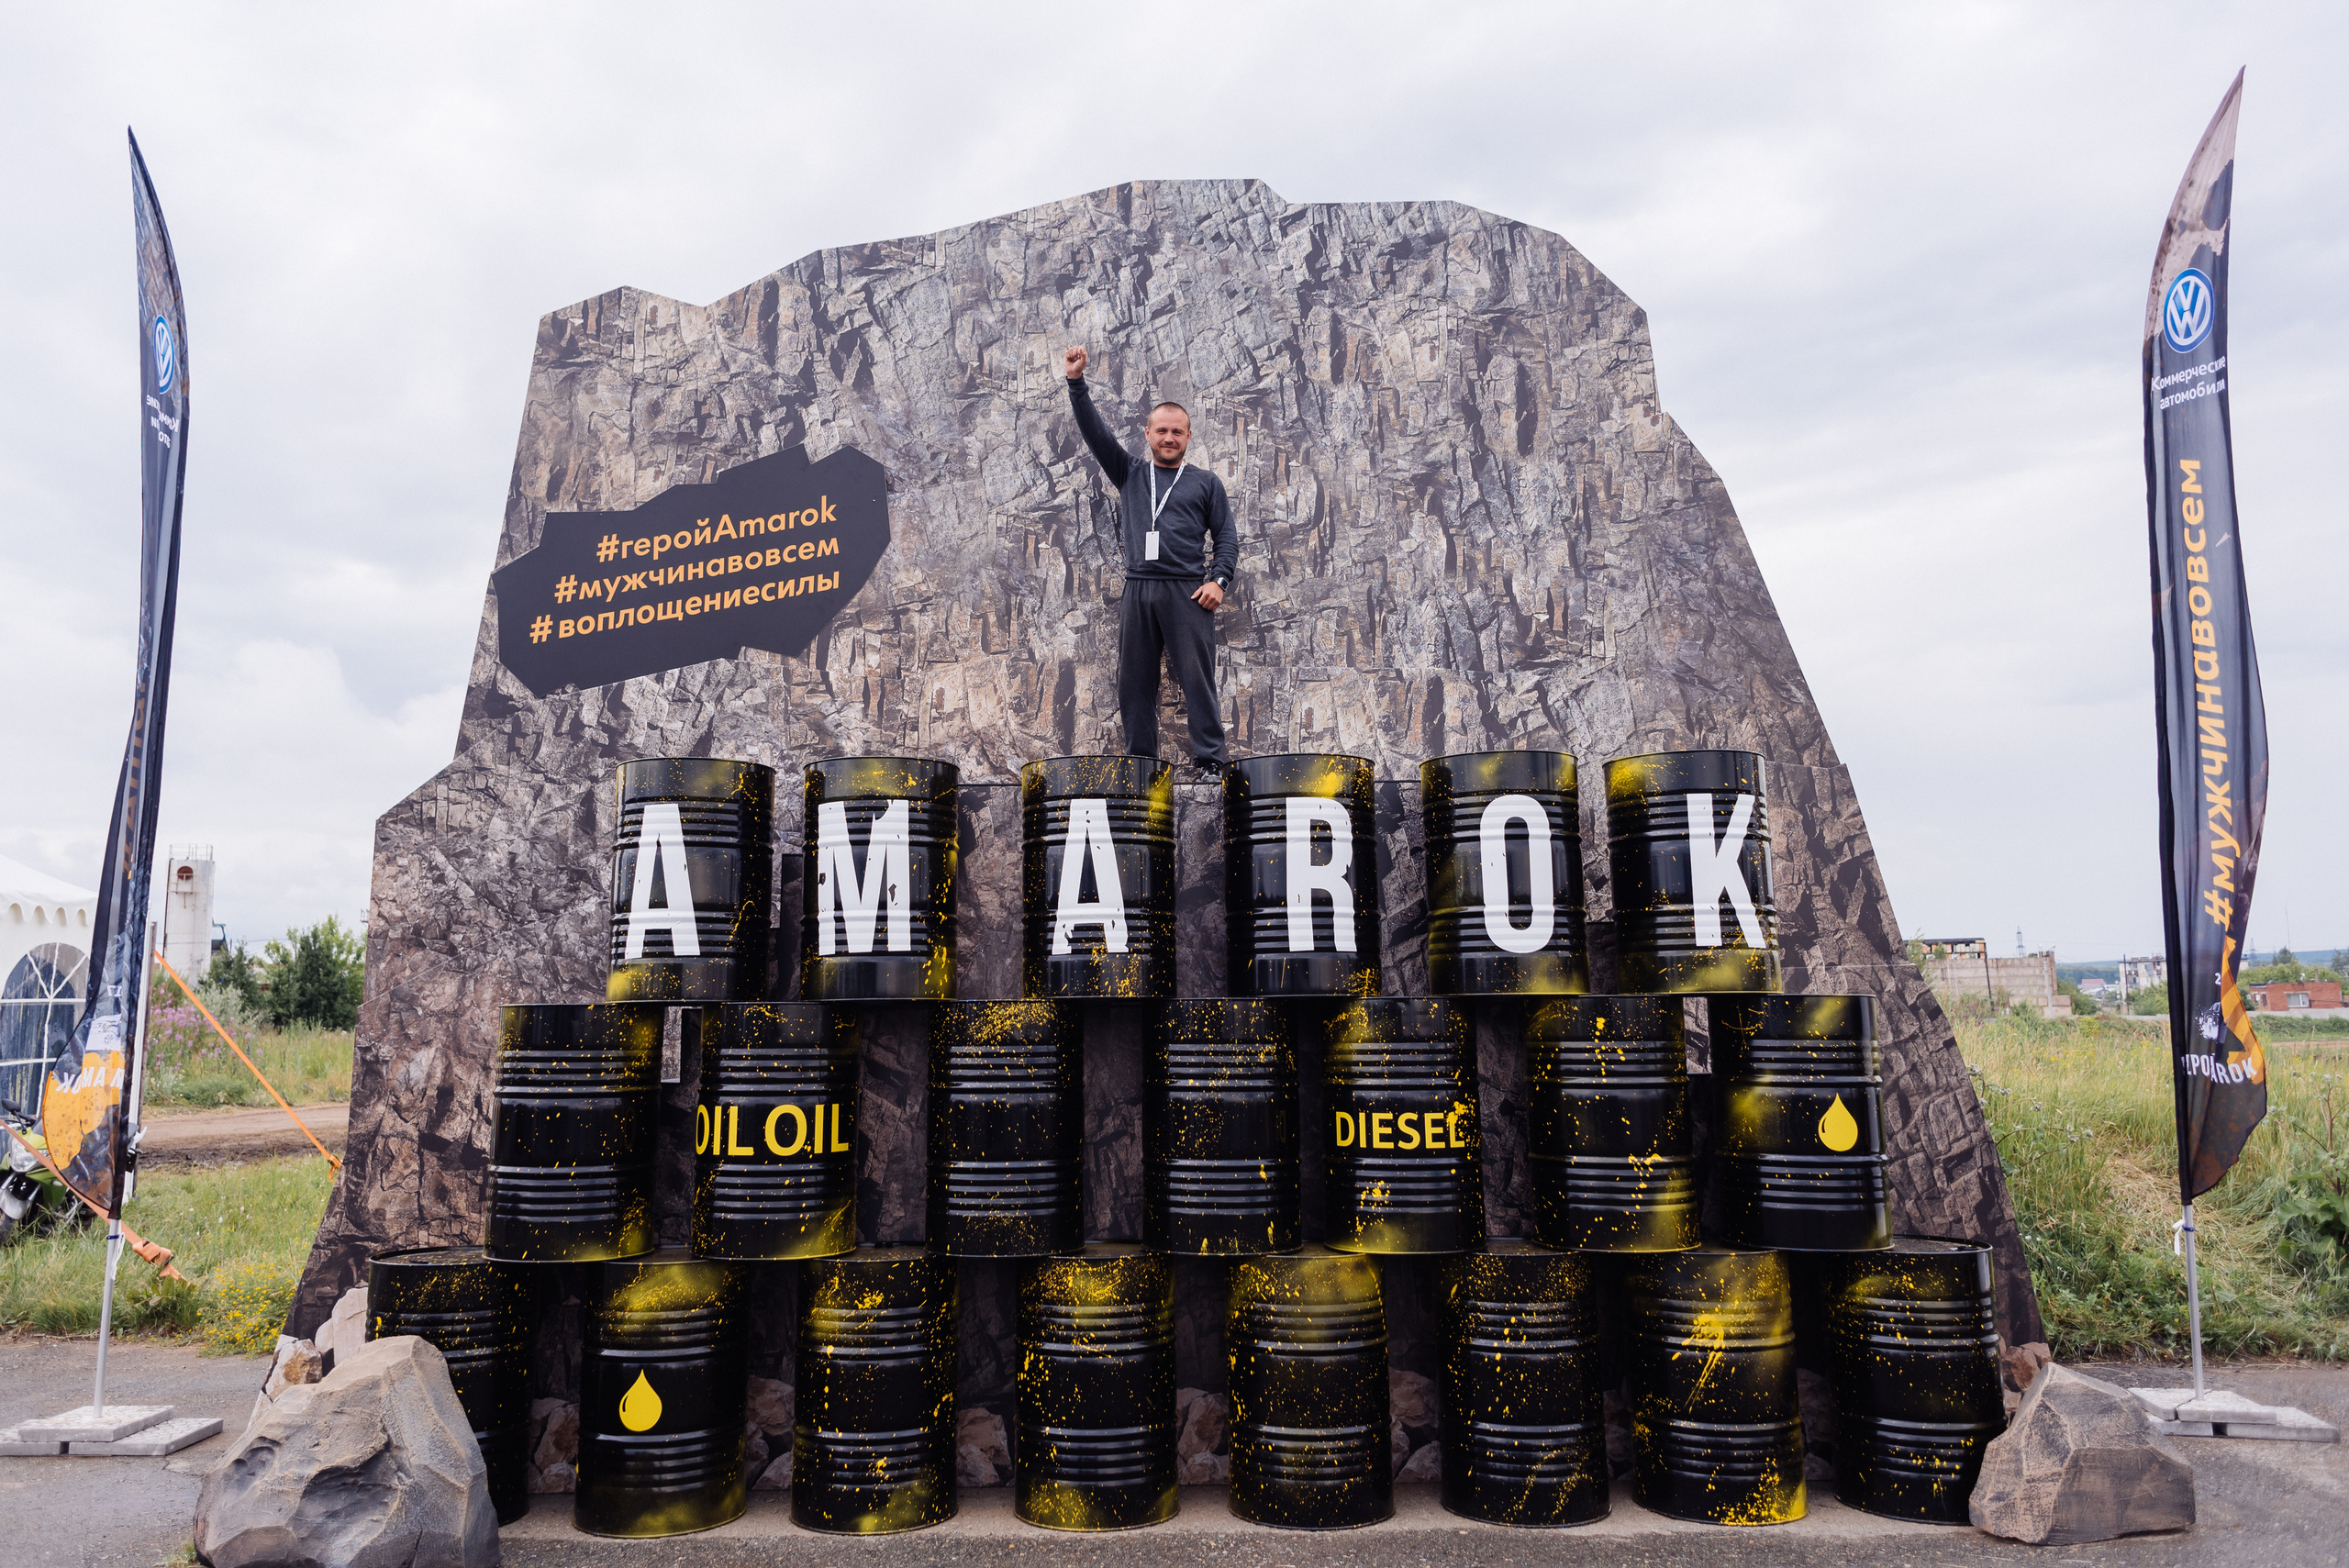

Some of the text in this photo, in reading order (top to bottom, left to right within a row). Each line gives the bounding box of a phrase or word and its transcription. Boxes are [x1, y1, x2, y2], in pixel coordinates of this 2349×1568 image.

[596, 495, 838, 563] #геройAmarok
[554, 537, 840, 604] #мужчинавовсем
[2179, 459, 2241, 932] #мужчинавовсем
[695, 1103, 850, 1157] OIL OIL
[1335, 1110, 1465, 1150] DIESEL
